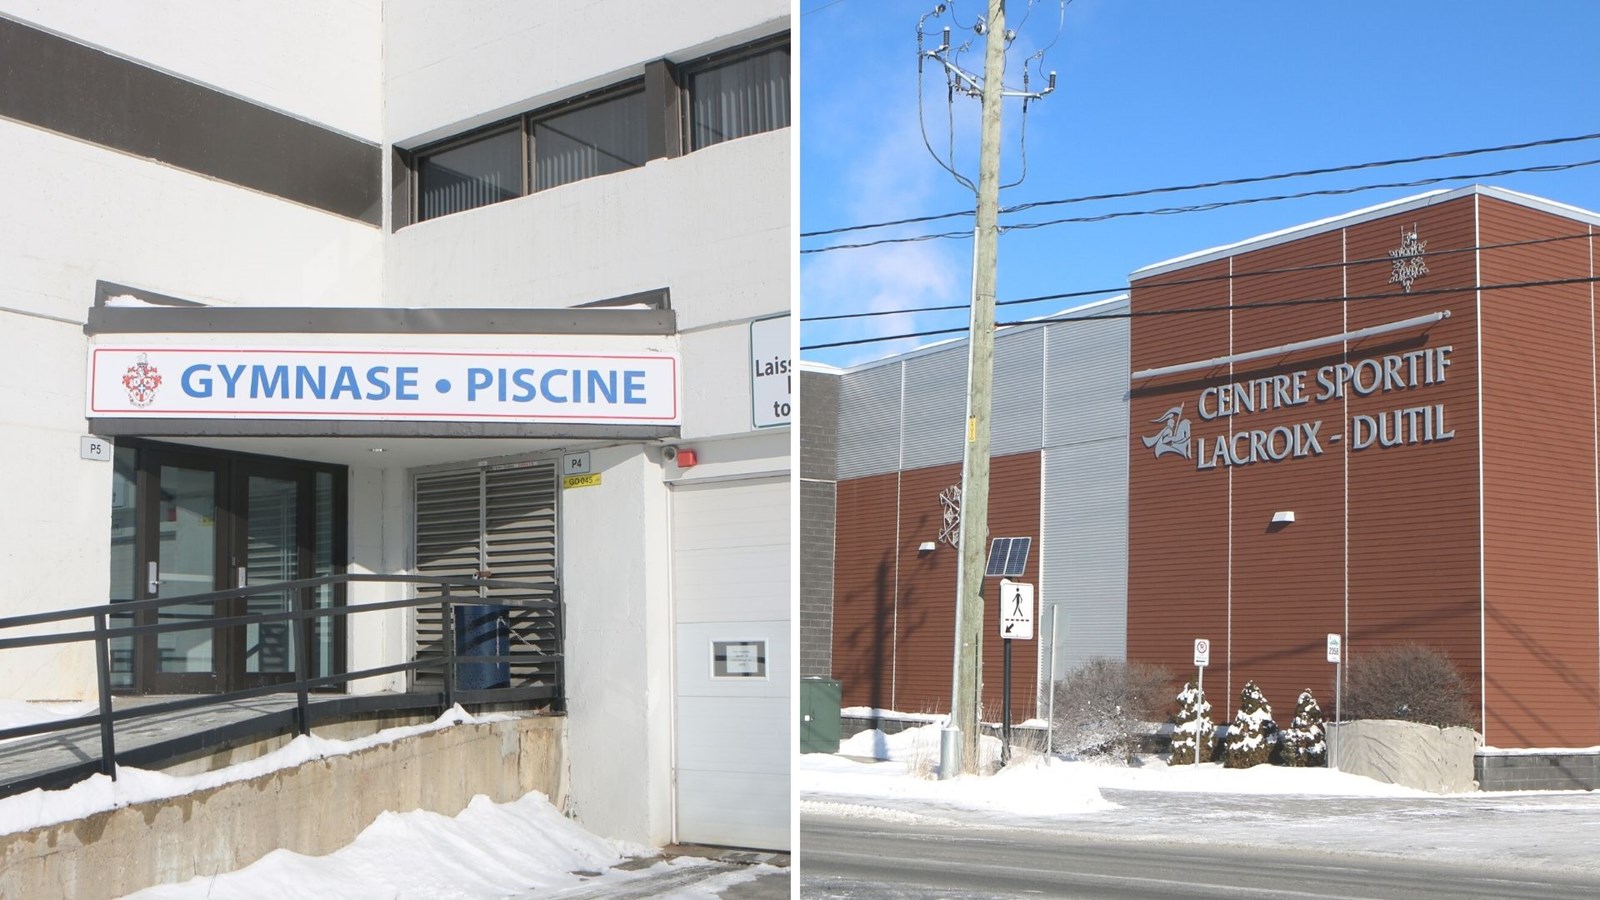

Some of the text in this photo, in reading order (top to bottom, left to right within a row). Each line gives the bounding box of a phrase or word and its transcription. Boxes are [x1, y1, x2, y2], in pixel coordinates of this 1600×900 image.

[180, 363, 420, 401] GYMNASE
[466, 366, 648, 405] PISCINE
[1198, 345, 1453, 420] CENTRE SPORTIF
[90, 443, 102, 455] P5
[1197, 421, 1324, 469] LACROIX
[1353, 403, 1456, 449] DUTIL
[571, 459, 582, 469] P4
